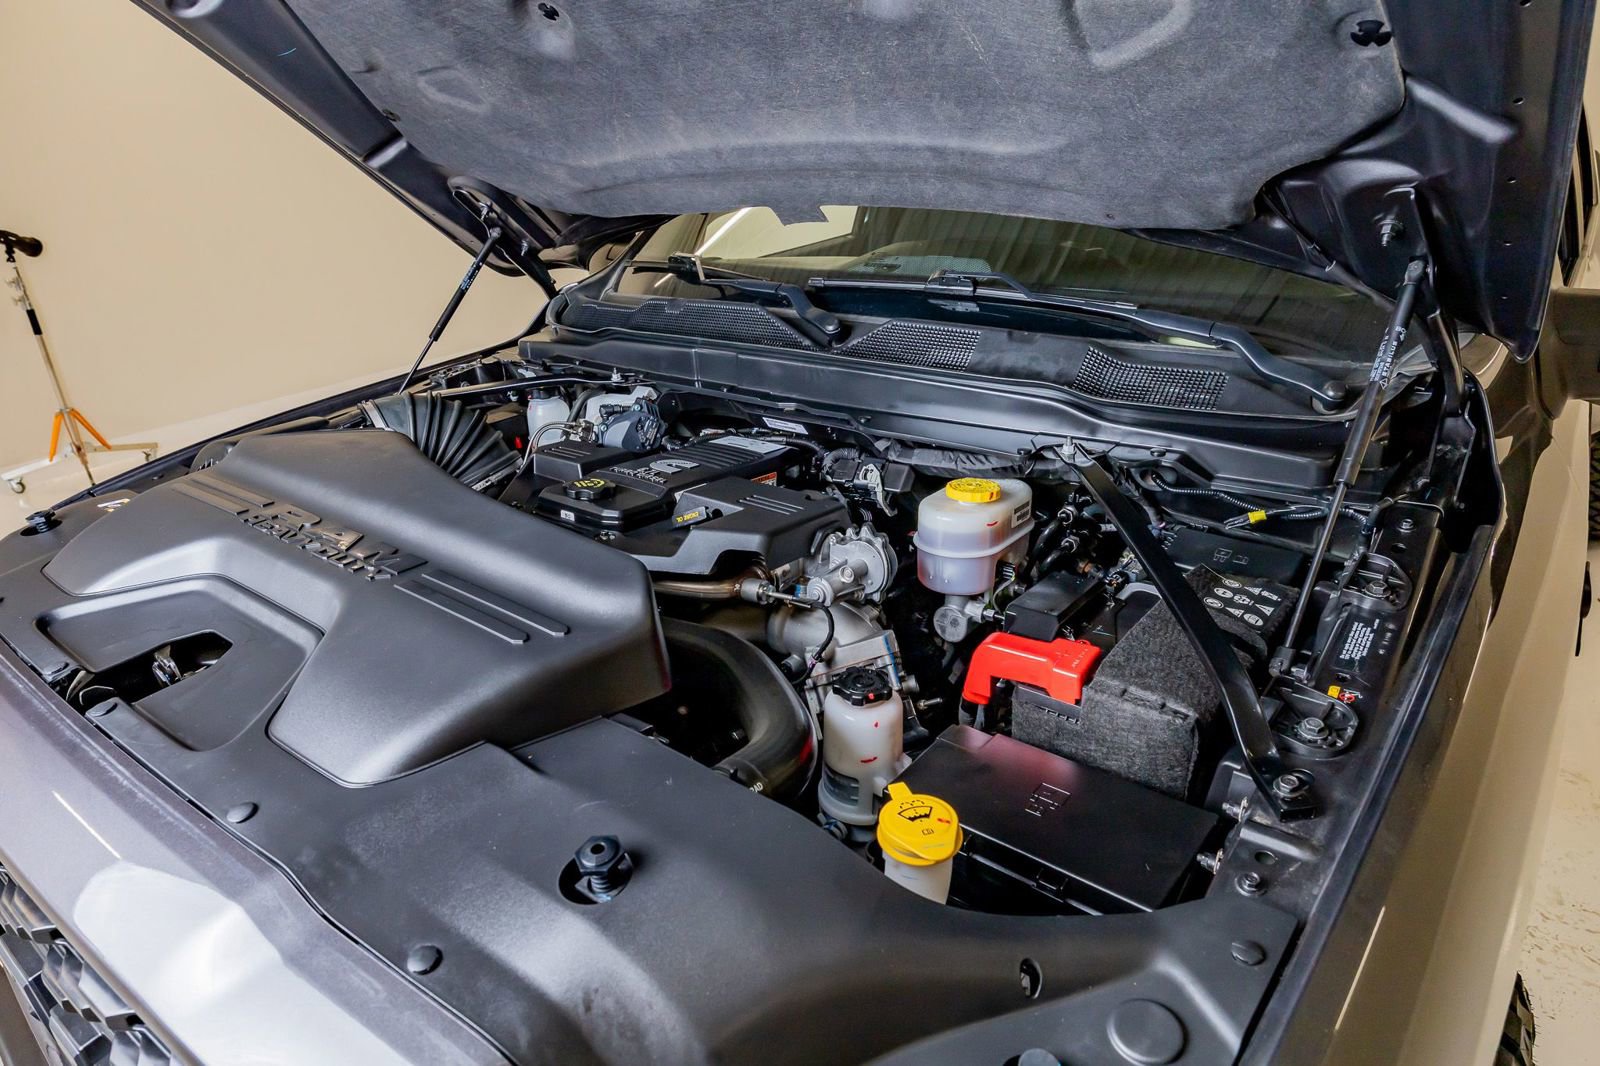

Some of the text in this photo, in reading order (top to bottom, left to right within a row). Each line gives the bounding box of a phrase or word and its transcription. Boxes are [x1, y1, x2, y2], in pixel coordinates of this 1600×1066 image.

[239, 513, 392, 581] HEAVY DUTY
[258, 503, 429, 575] RAM
